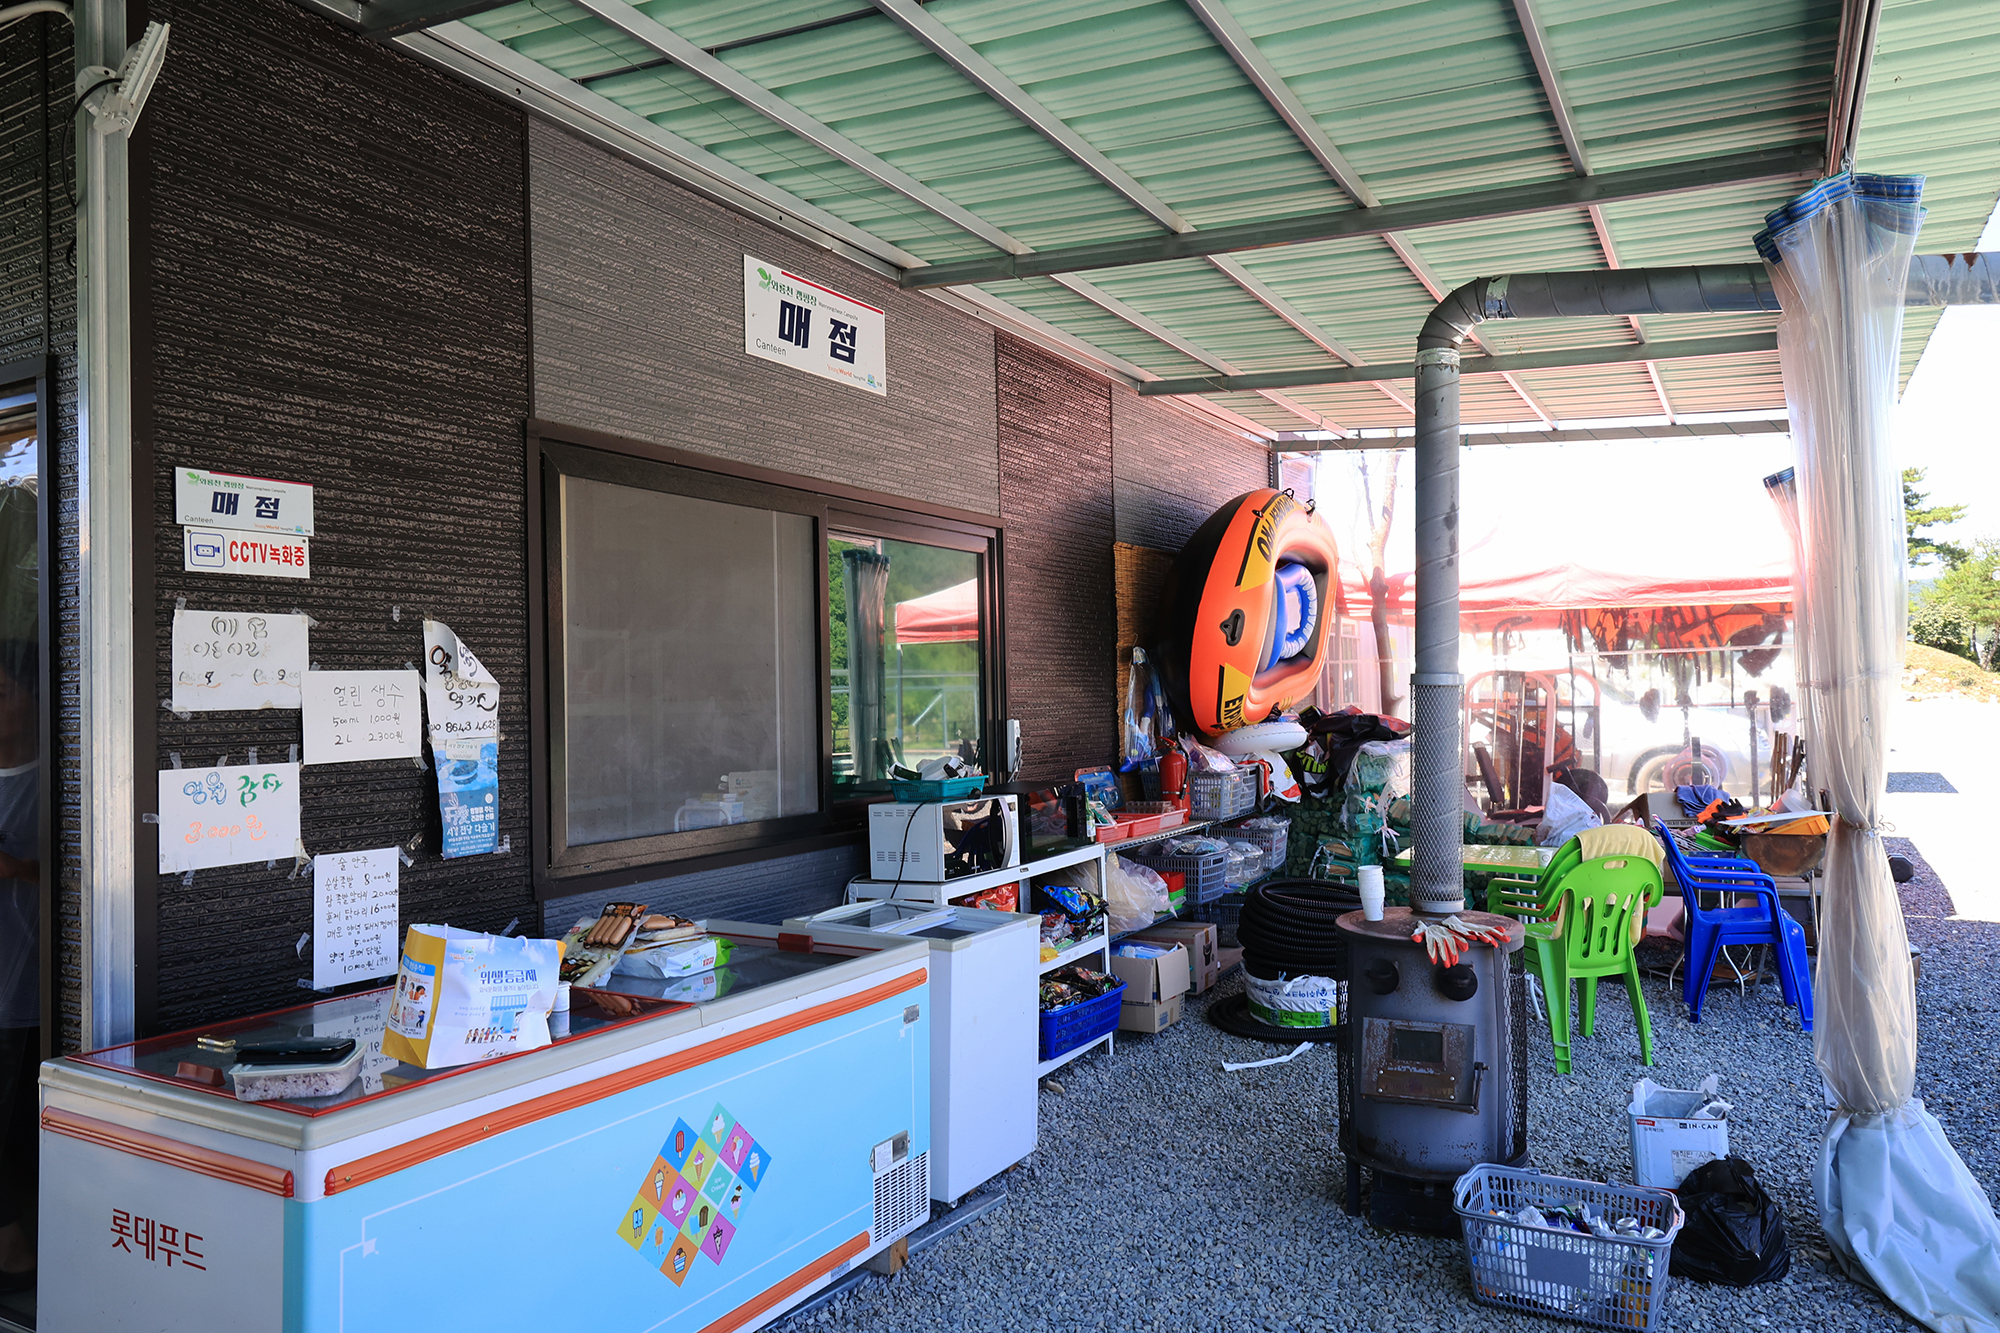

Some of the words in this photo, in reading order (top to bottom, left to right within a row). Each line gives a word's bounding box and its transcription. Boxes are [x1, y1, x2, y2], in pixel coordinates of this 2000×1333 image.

[756, 338, 788, 356] Canteen
[184, 515, 214, 524] Canteen
[1256, 519, 1275, 563] PRO
[229, 540, 304, 567] CCTV녹화중
[334, 684, 362, 707] 얼린
[371, 683, 404, 708] 생수
[446, 721, 472, 733] 8643
[237, 773, 284, 808] 감자
[474, 822, 496, 834] 다슬기
[326, 910, 341, 924] 훈제
[326, 926, 343, 940] 매운
[328, 951, 345, 964] 양념
[480, 969, 538, 985] 위생등급제
[110, 1208, 206, 1271] 롯데푸드
